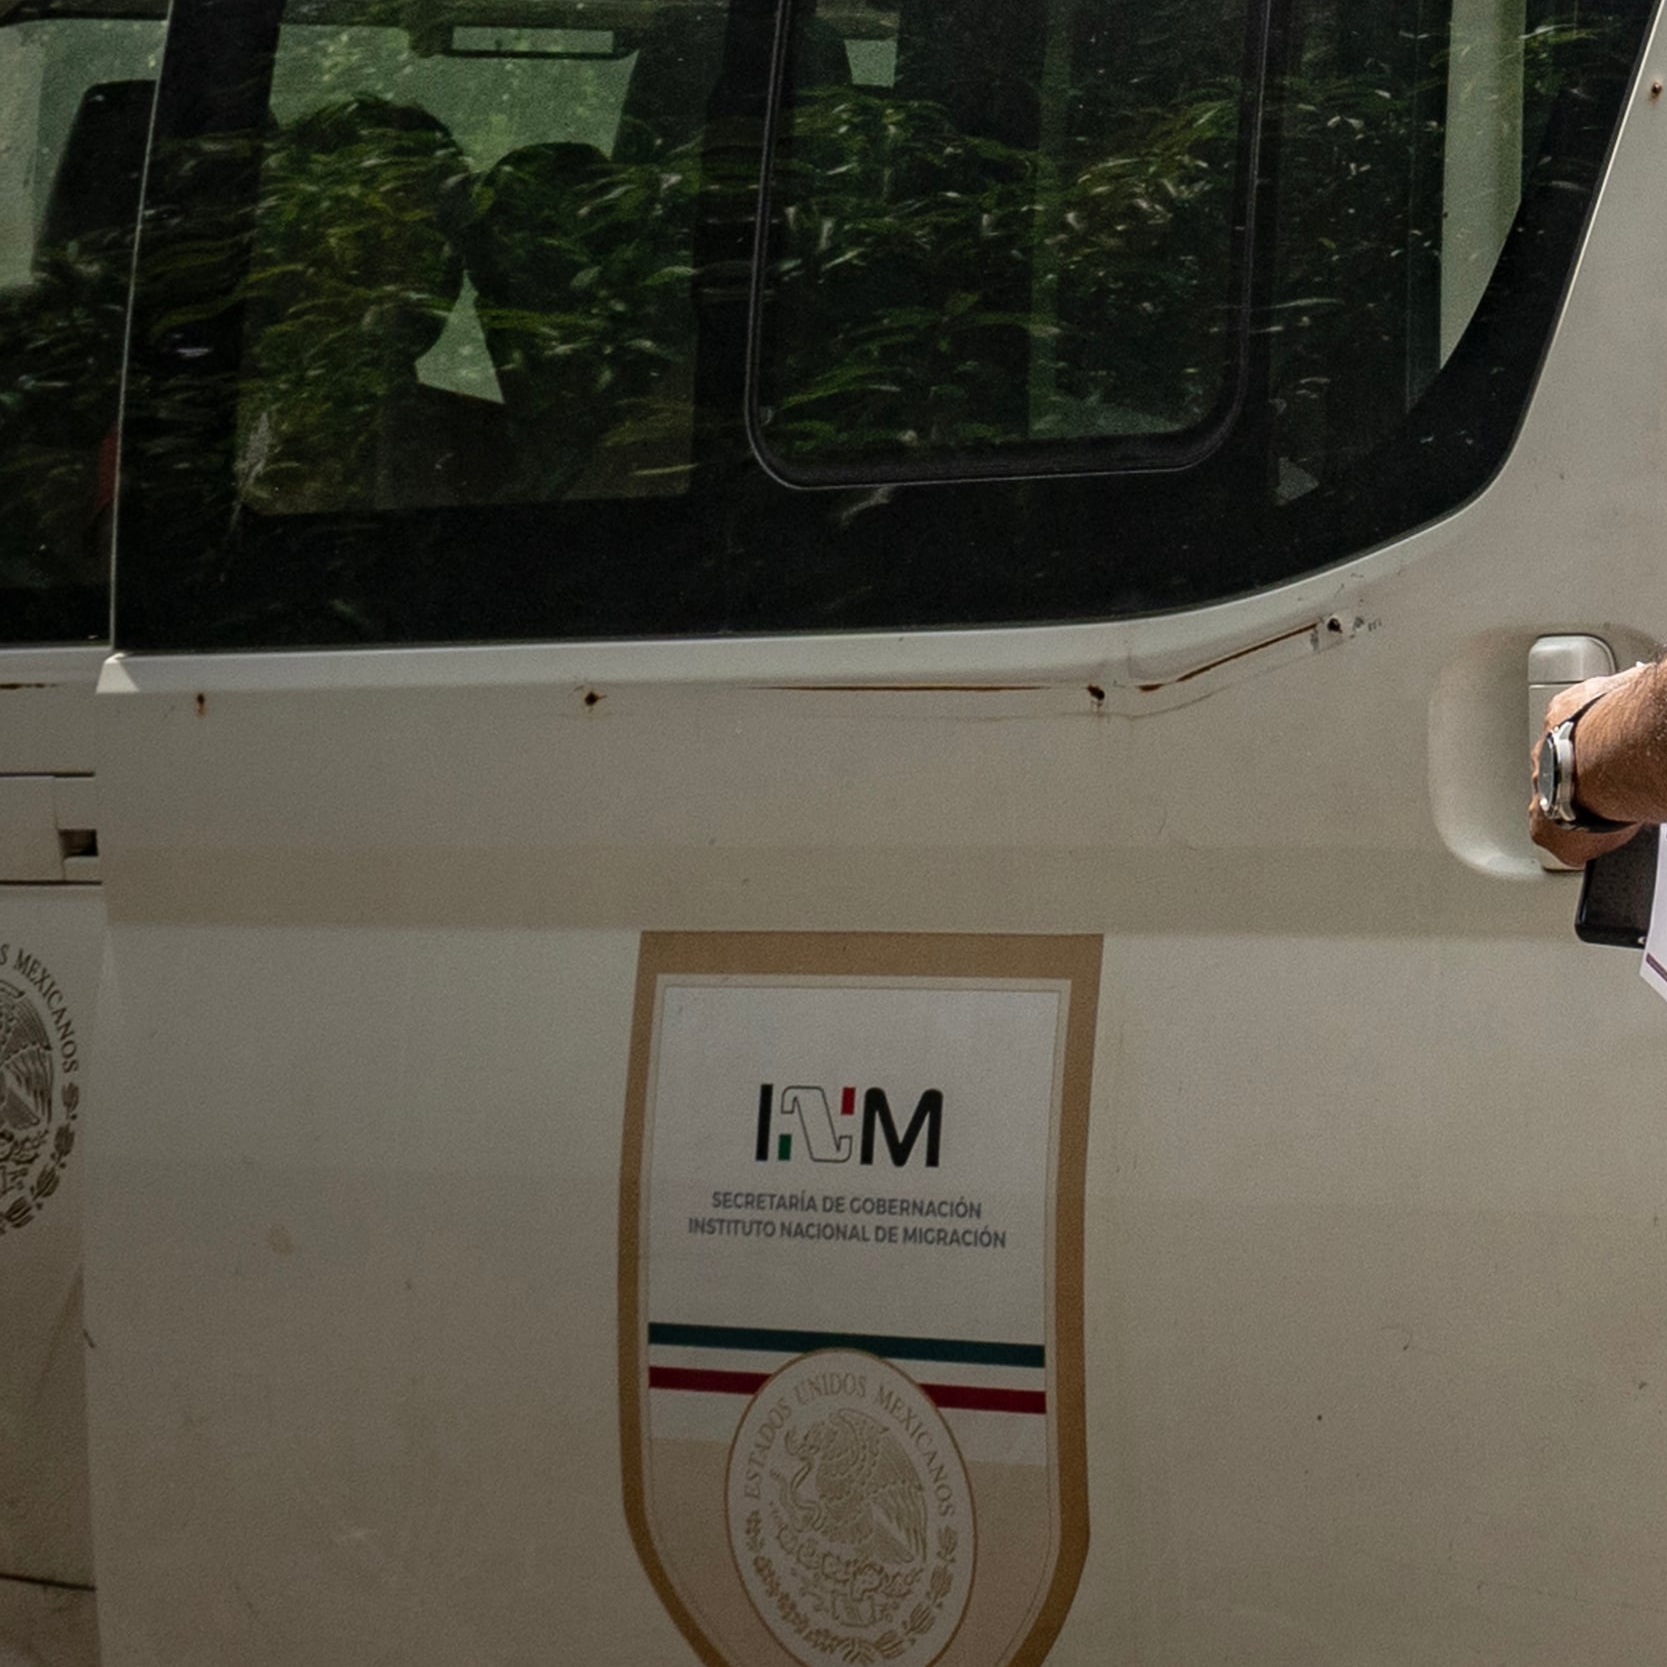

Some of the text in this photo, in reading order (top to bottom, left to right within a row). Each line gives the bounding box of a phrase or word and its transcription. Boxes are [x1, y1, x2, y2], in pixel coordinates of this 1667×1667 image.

[13, 947, 79, 1073] MEXICANOS
[755, 1083, 944, 1168] INM
[688, 1217, 1006, 1248] INSTITUTO NACIONAL DE MIGRACIÓN
[711, 1189, 982, 1219] SECRETARÍA DE GOBERNACIÓN
[743, 1372, 956, 1517] ESTADOS UNIDOS MEXICANOS
